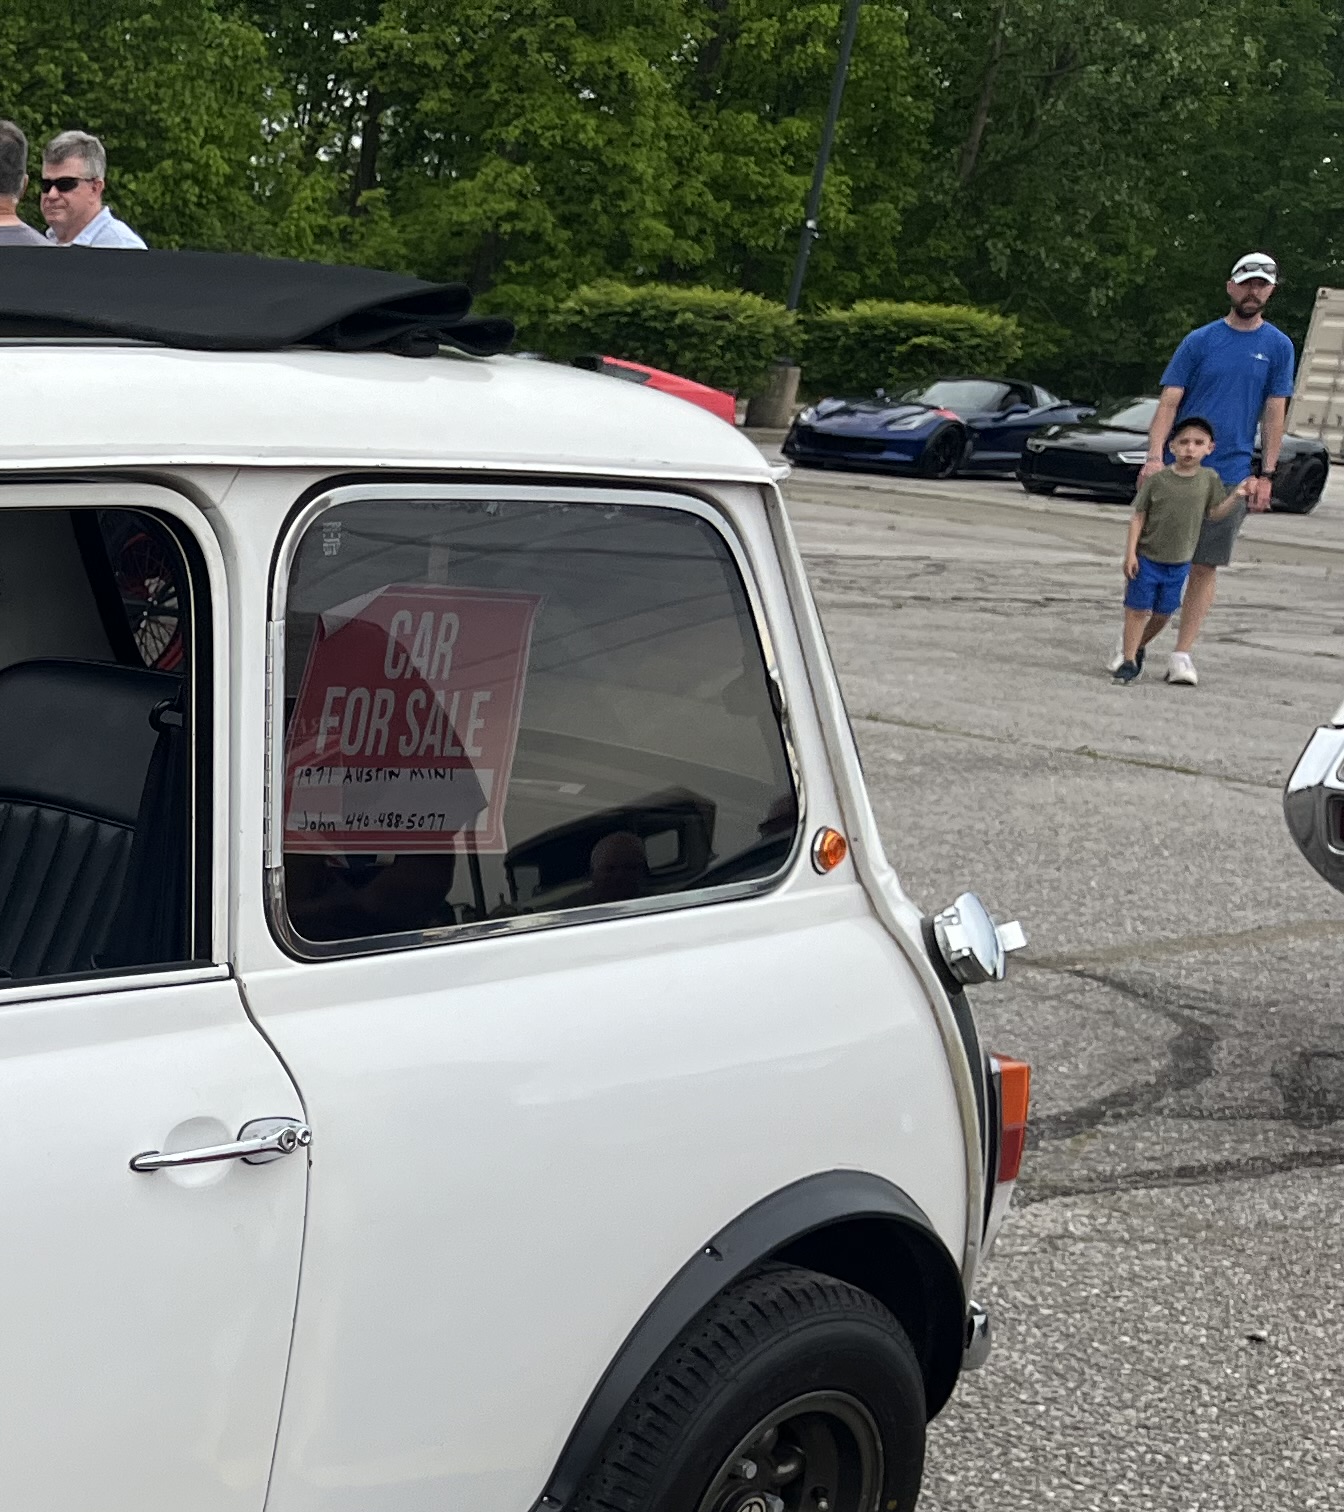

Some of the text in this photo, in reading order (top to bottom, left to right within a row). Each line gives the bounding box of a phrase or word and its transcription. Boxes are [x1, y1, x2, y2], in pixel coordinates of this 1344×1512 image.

[384, 609, 460, 680] CAR
[314, 686, 492, 758] FOR SALE
[298, 766, 454, 786] 1971 AUSTIN MINI
[298, 811, 336, 832] John
